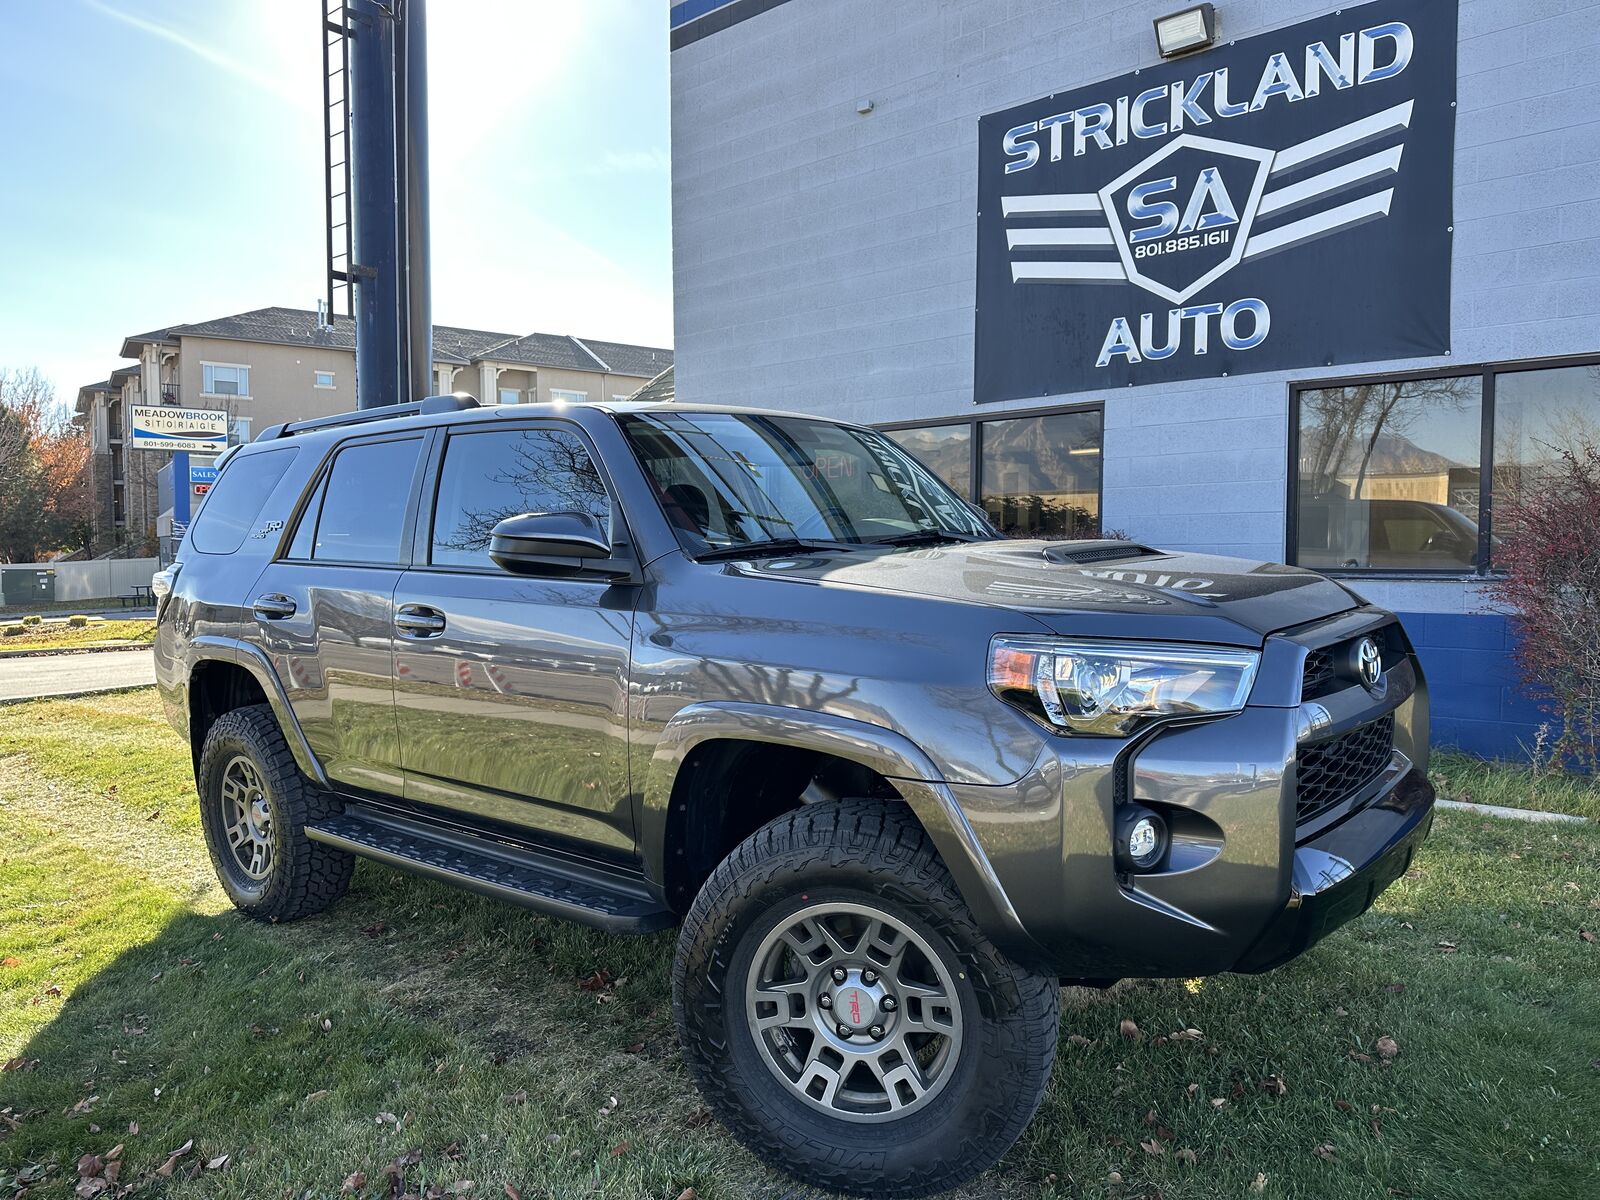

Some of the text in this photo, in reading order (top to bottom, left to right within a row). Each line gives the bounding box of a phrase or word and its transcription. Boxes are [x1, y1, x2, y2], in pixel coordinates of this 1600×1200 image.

[1003, 21, 1414, 174] STRICKLAND
[1127, 167, 1240, 244] SA
[1135, 229, 1230, 259] 801.885.1611
[1095, 298, 1271, 367] AUTO
[134, 409, 225, 421] MEADOWBROOK
[143, 440, 196, 449] 801-599-6083
[849, 991, 860, 1024] TRD
